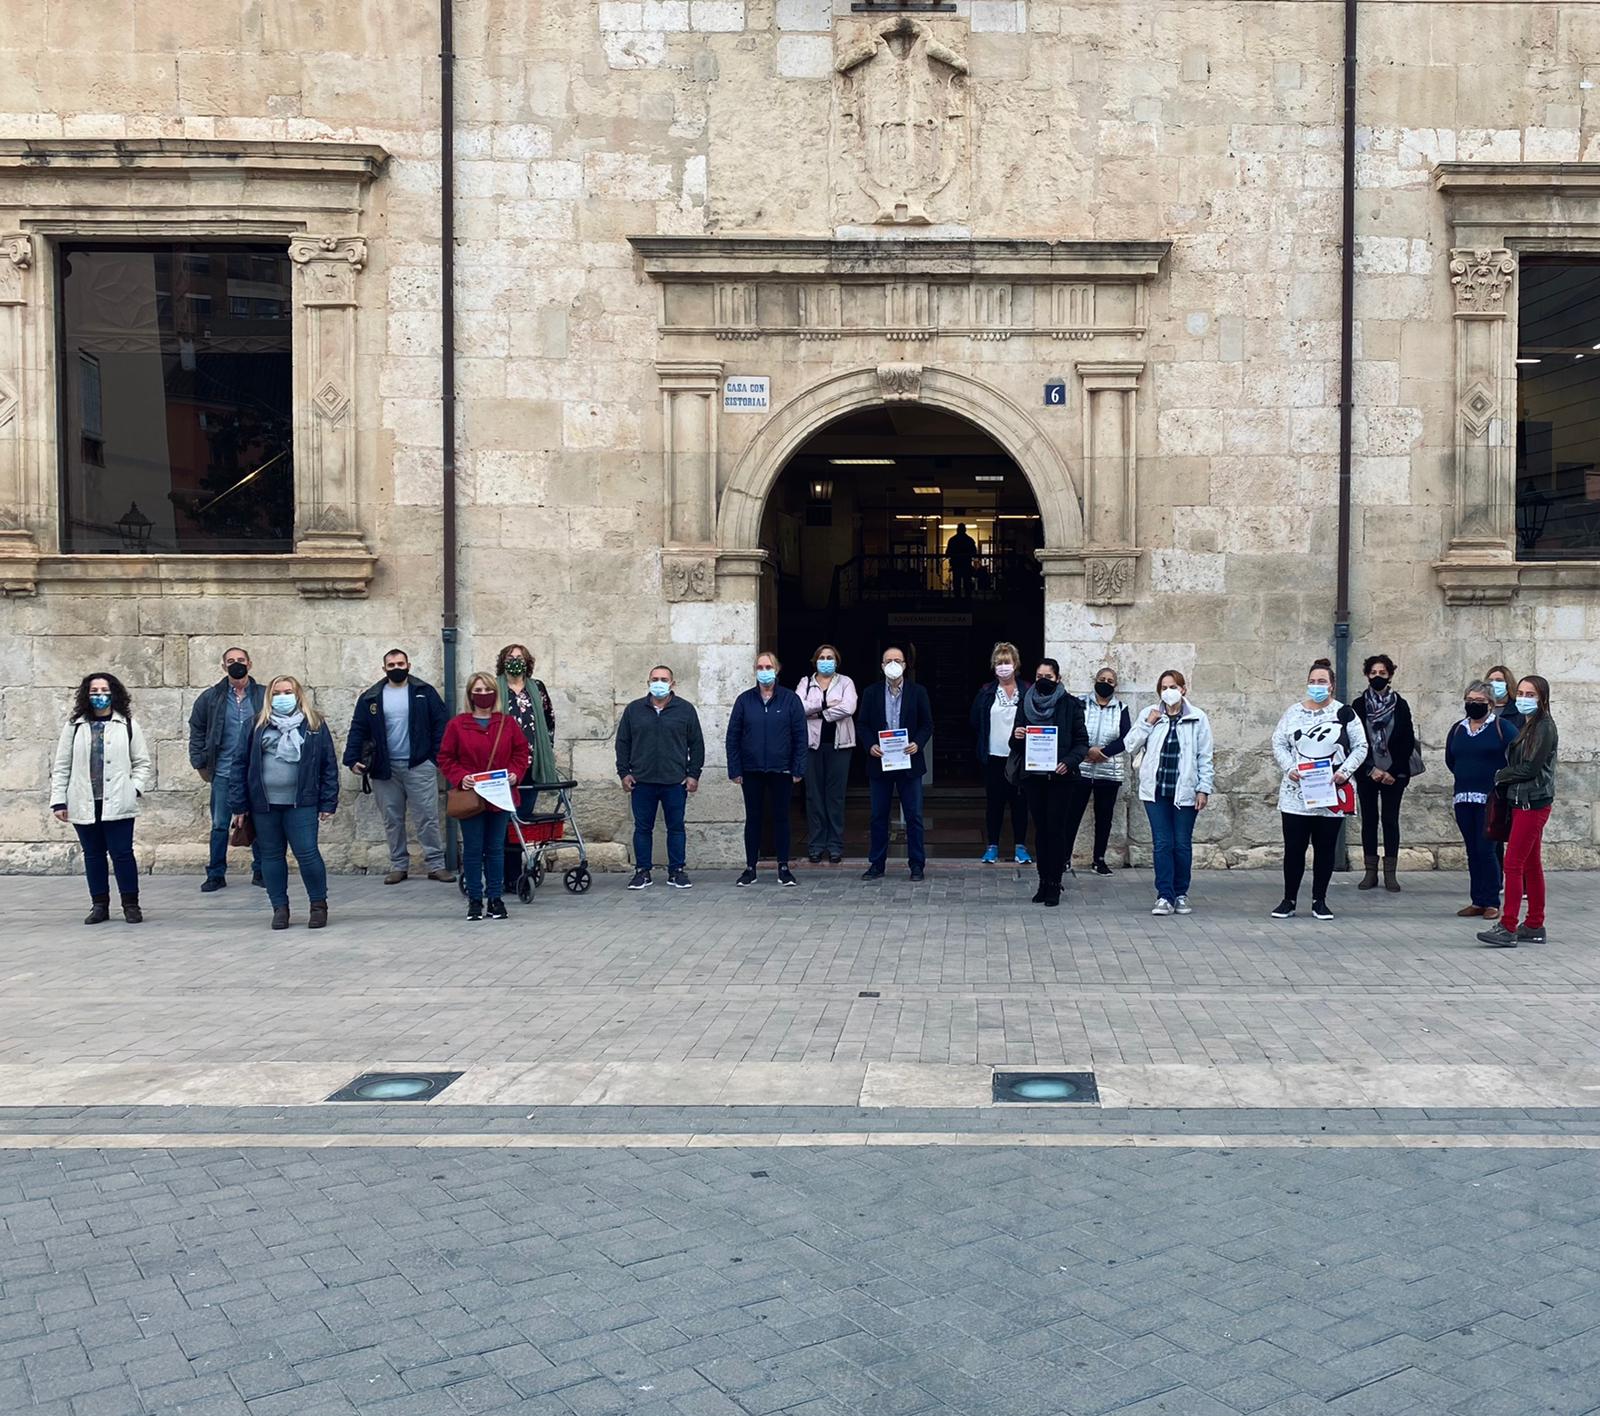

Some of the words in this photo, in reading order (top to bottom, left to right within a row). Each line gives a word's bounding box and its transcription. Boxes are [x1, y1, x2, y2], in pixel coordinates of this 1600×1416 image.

[727, 383, 747, 392] CASA
[750, 384, 764, 392] CON
[1051, 386, 1060, 403] 6
[725, 397, 767, 406] SISTORIAL
